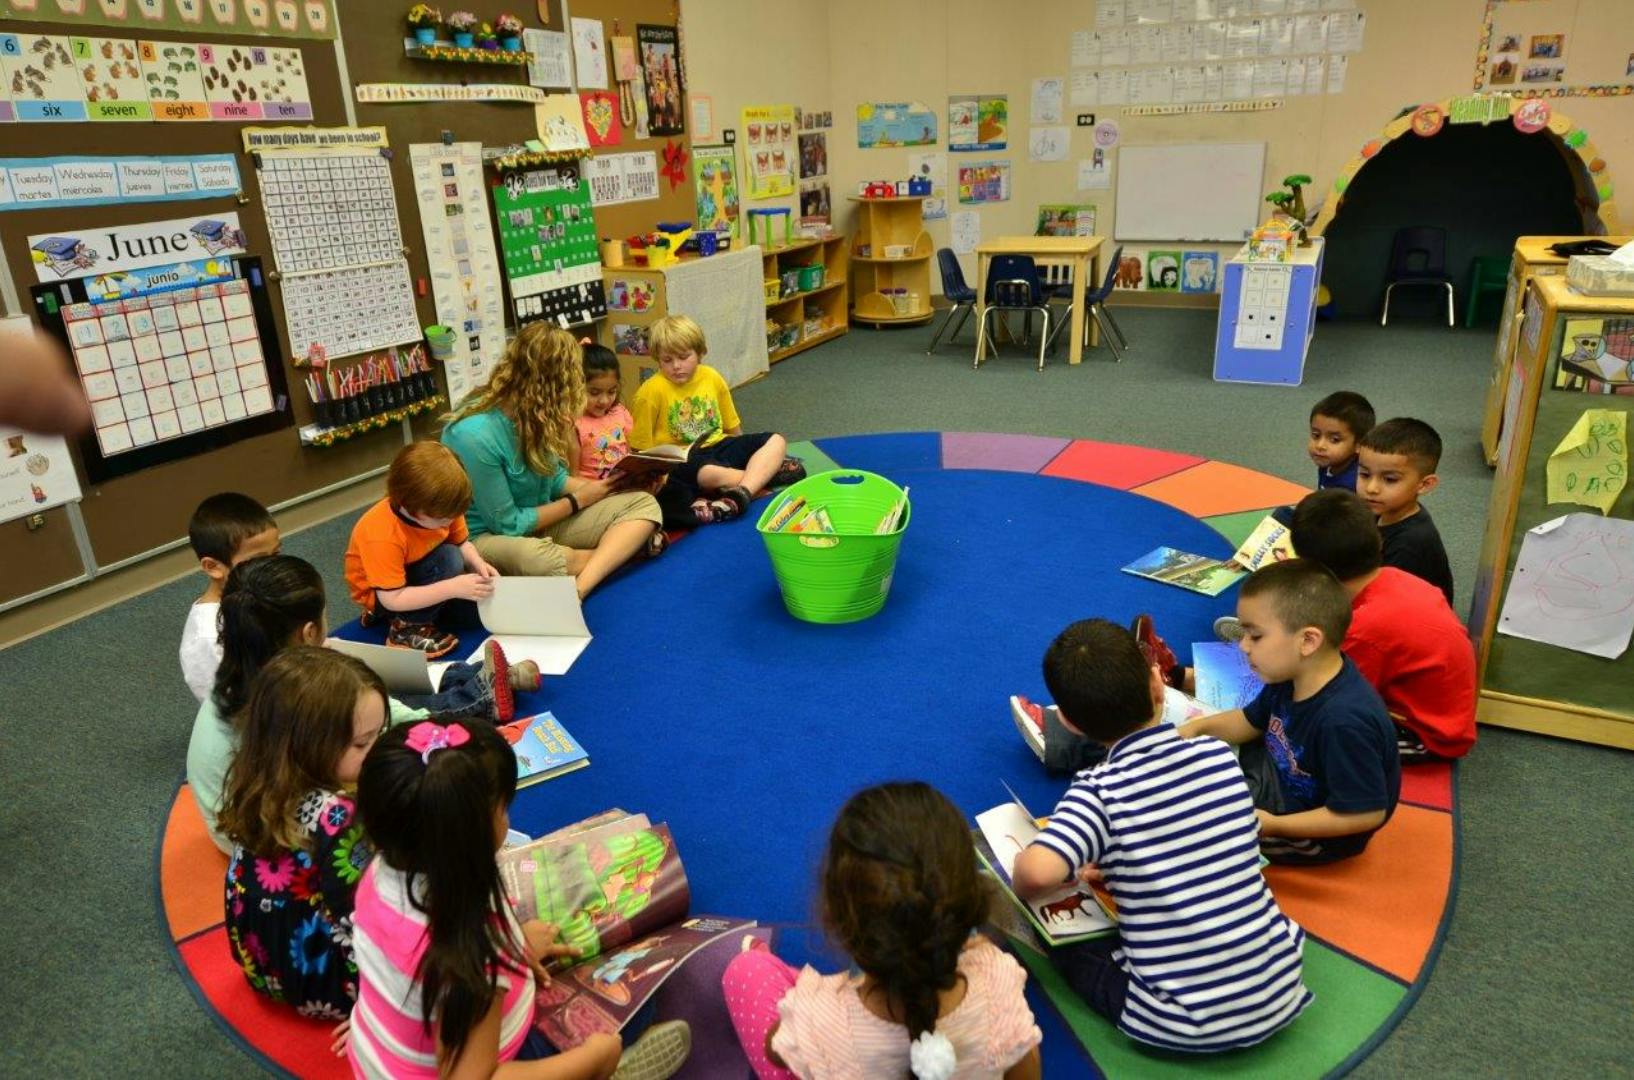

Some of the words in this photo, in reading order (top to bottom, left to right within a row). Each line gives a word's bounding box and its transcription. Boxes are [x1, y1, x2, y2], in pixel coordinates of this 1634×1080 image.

[4, 39, 15, 52] 6
[78, 42, 85, 54] 7
[143, 46, 151, 57] 8
[203, 48, 210, 60] 9
[254, 51, 265, 63] 10
[42, 103, 62, 116] six
[100, 105, 138, 116] seven
[166, 104, 195, 118] eight
[224, 104, 248, 116] nine
[279, 104, 295, 115] ten
[58, 168, 113, 181] Wednesday
[122, 165, 161, 177] Thursday
[165, 166, 189, 177] Friday
[13, 172, 53, 185] Tuesday
[19, 189, 52, 199] martes
[125, 182, 152, 194] jueves
[105, 232, 189, 262] June
[146, 271, 179, 288] junio
